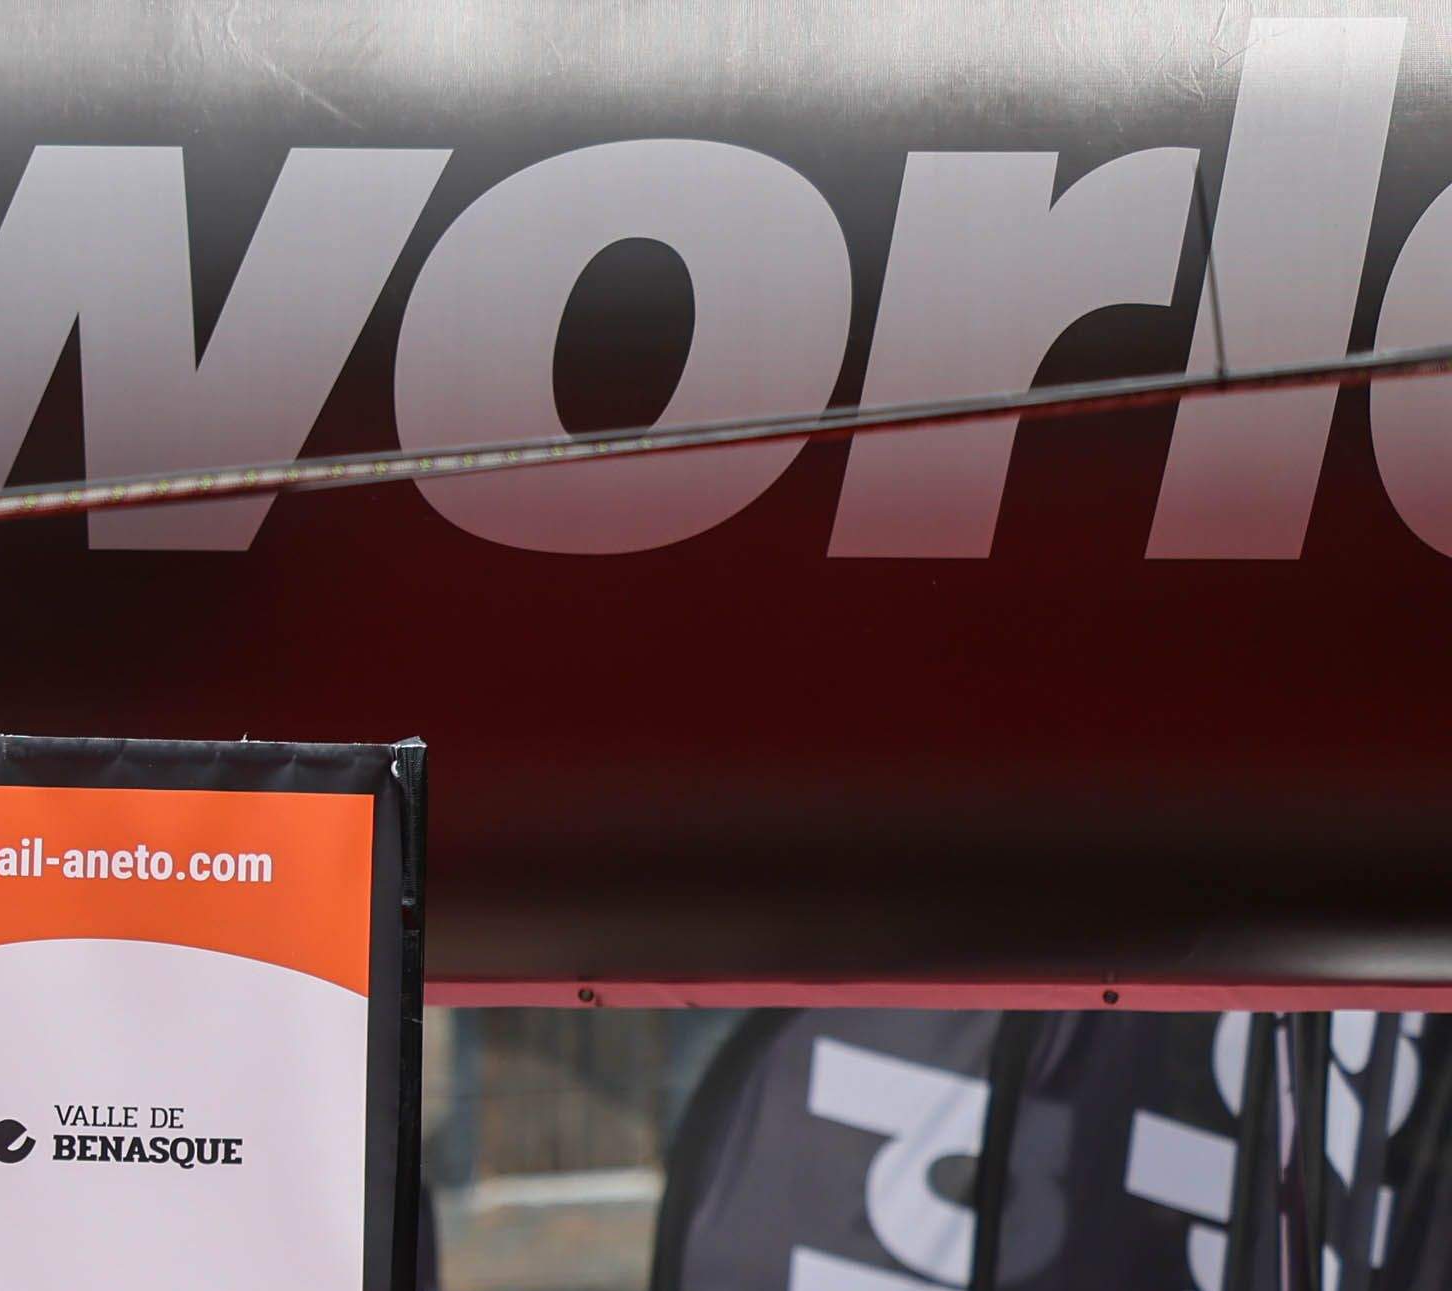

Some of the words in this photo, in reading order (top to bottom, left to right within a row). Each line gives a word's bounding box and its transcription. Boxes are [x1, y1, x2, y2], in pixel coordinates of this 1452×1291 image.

[53, 1103, 139, 1129] VALLE
[149, 1106, 185, 1130] DE
[52, 1134, 244, 1170] BENASQUE
